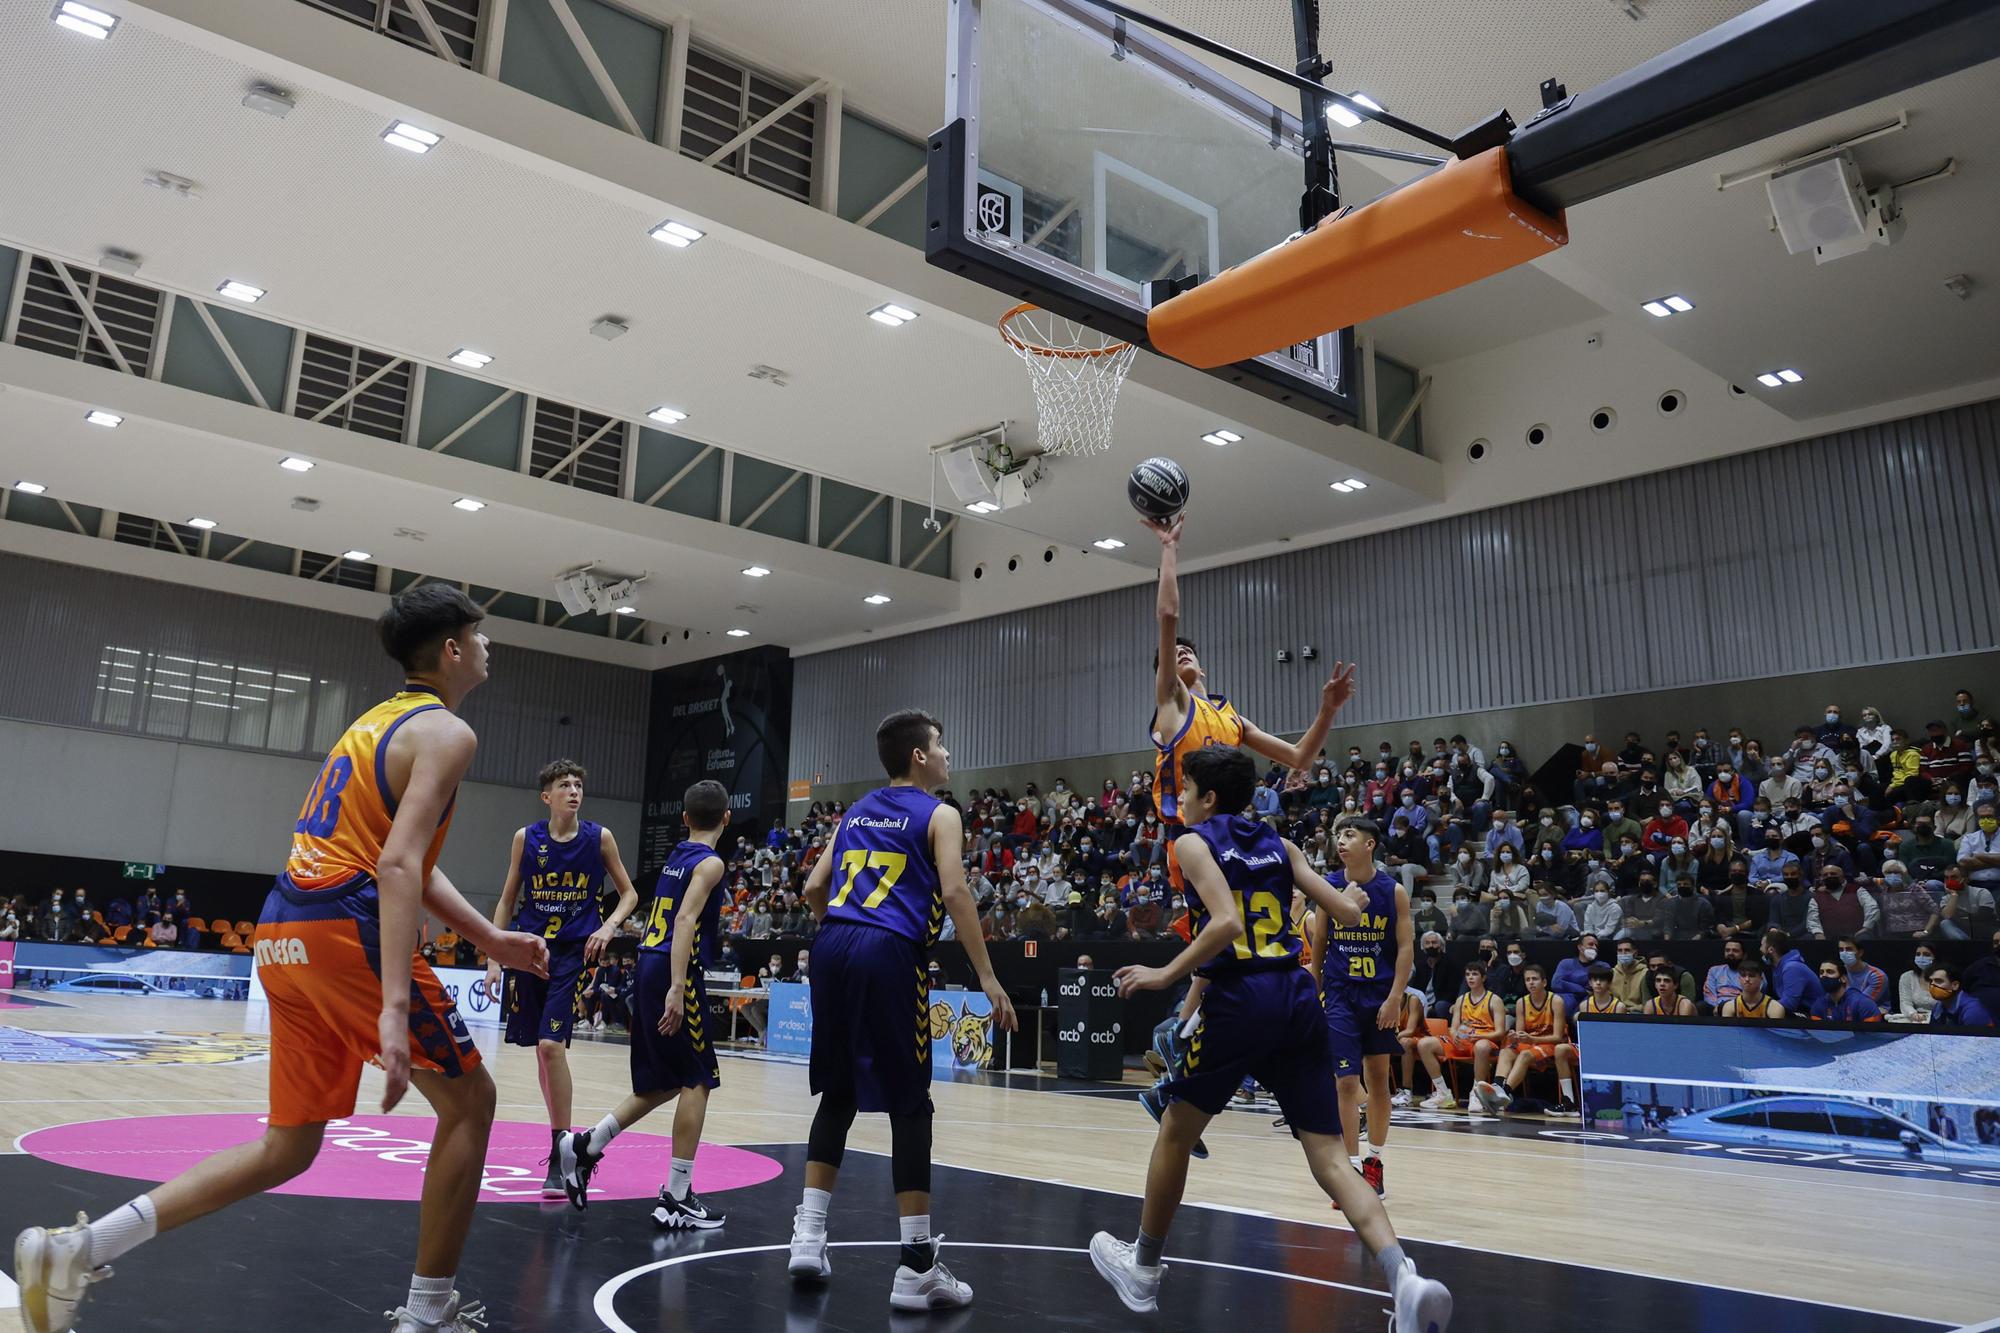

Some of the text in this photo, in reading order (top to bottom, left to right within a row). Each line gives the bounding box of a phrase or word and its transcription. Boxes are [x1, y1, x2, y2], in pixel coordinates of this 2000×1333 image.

[1137, 466, 1174, 496] MINICOPA
[688, 698, 720, 714] BASKET
[728, 793, 752, 809] MNIS
[860, 817, 902, 828] CaixaBank
[828, 850, 907, 909] 77
[535, 902, 566, 913] Redexis
[543, 915, 562, 939] 2
[1231, 890, 1291, 960] 12
[1332, 912, 1388, 930] UAM
[256, 937, 310, 967] MESA
[1339, 944, 1370, 954] Redexis
[1349, 956, 1376, 979] 20
[1060, 983, 1116, 998] acb acb
[1059, 1029, 1116, 1044] acb acb
